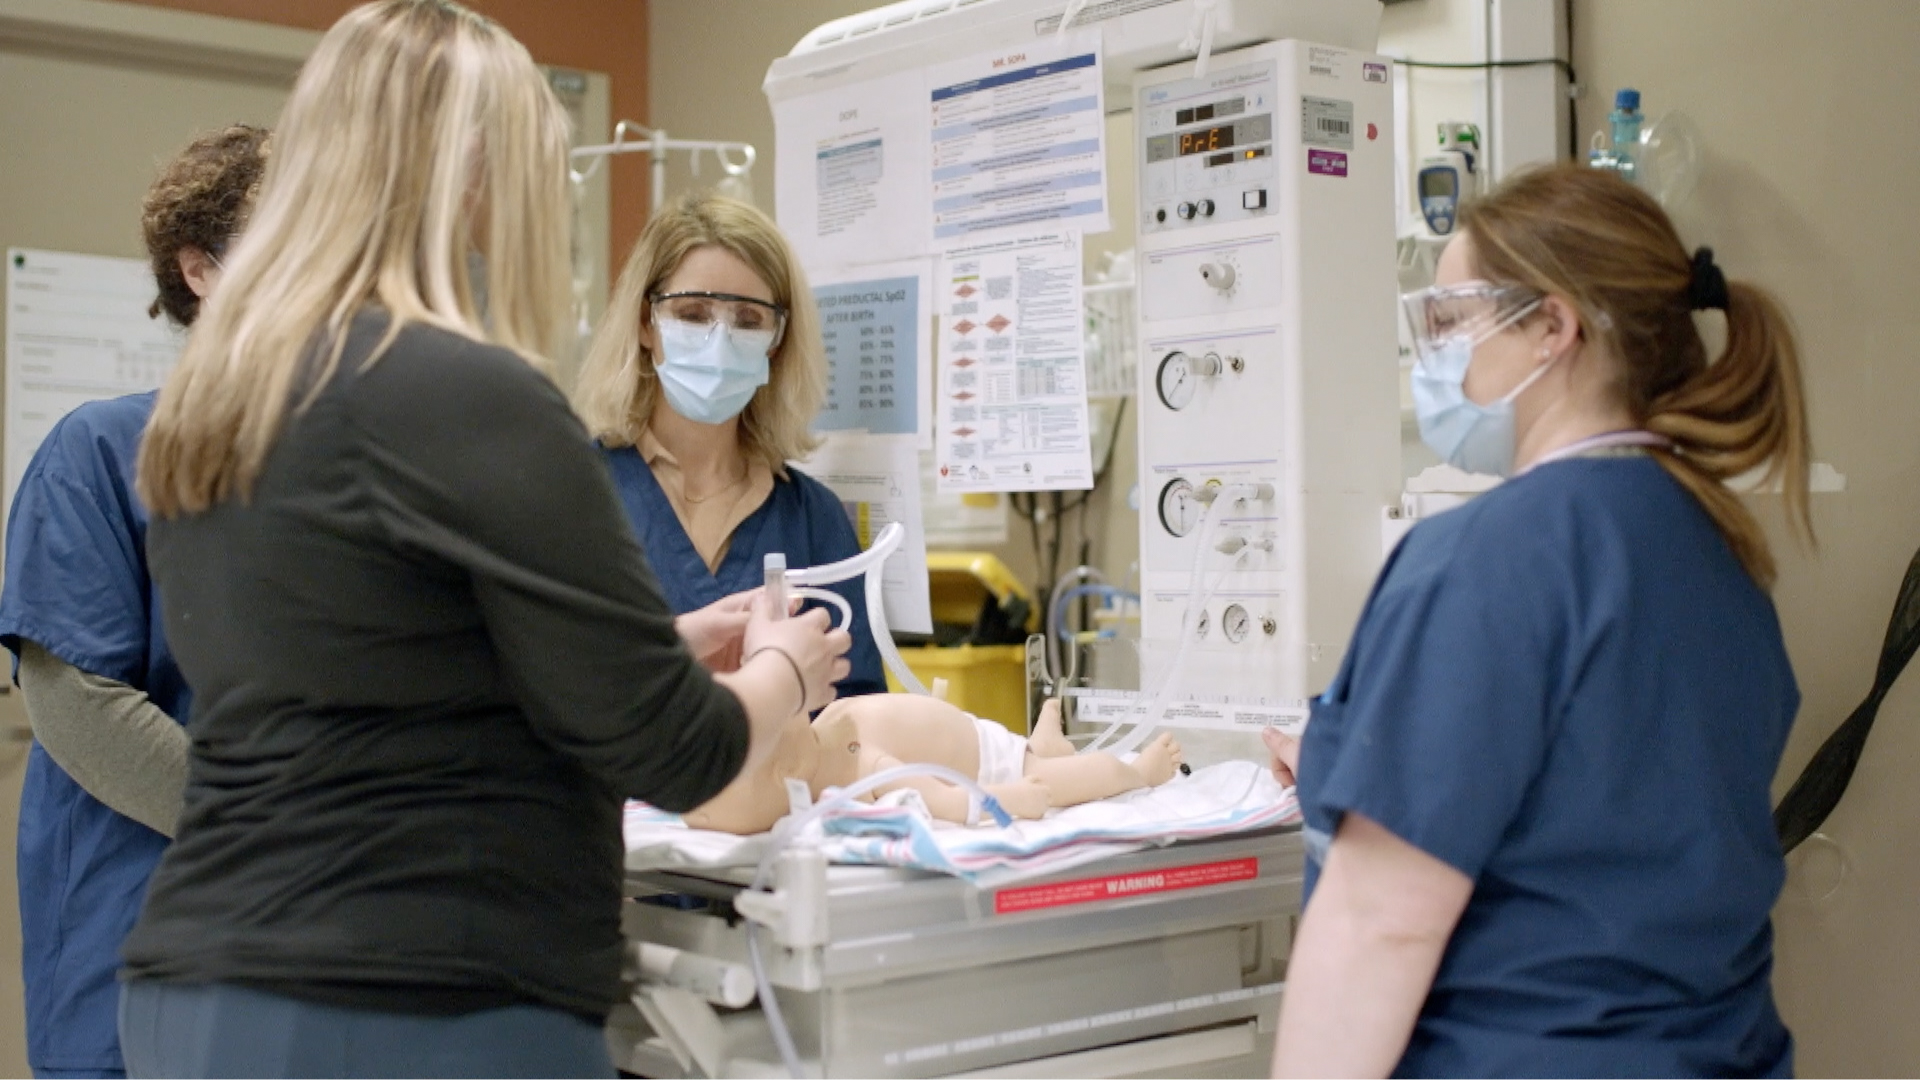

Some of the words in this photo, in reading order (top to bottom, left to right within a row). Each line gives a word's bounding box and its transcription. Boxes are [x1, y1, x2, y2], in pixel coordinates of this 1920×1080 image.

[1008, 53, 1026, 65] SOPA
[838, 292, 883, 305] PREDUCTAL
[826, 312, 849, 324] AFTER
[851, 310, 875, 322] BIRTH
[1106, 874, 1165, 894] WARNING
